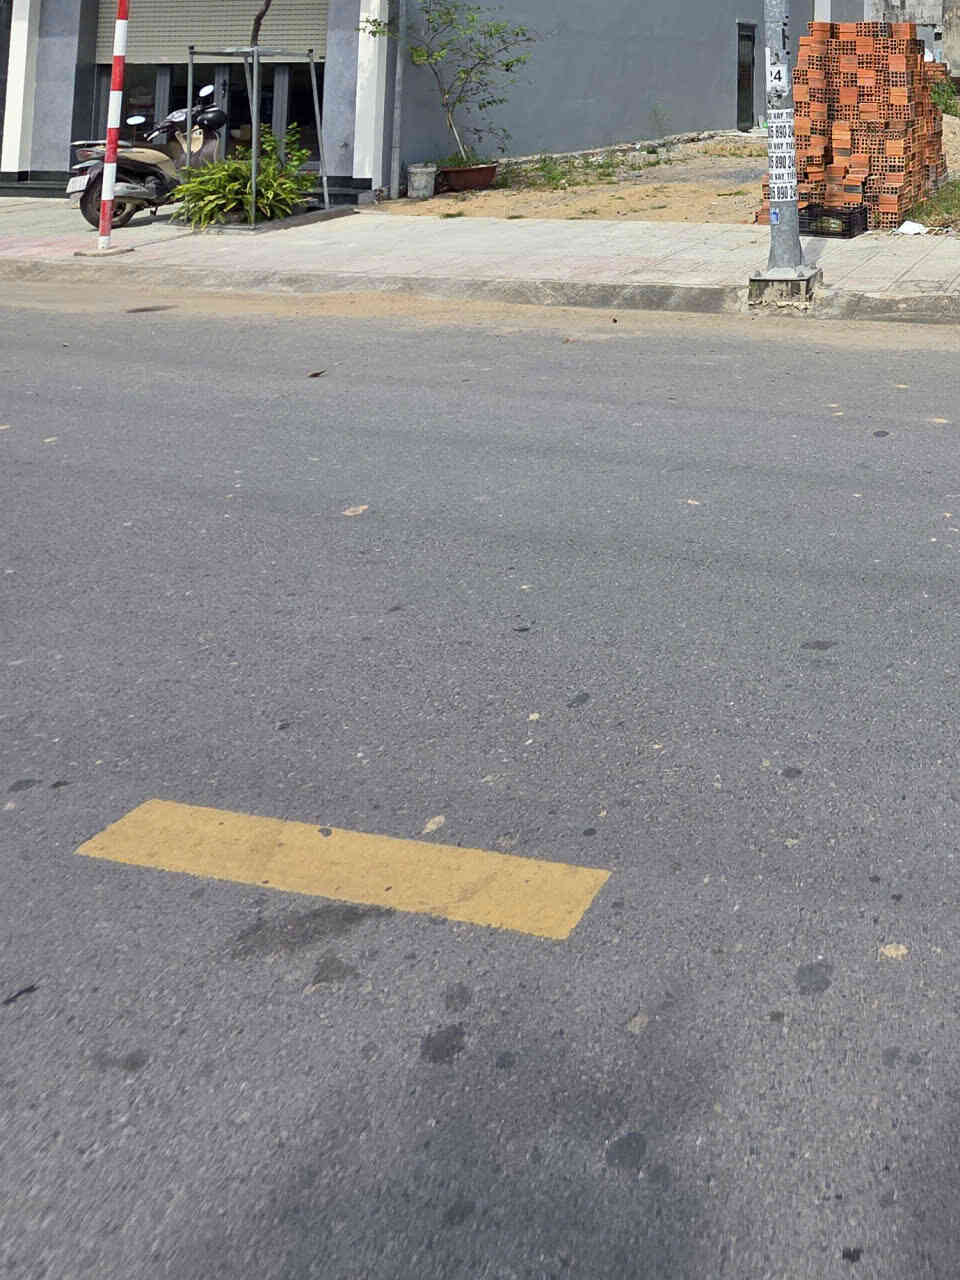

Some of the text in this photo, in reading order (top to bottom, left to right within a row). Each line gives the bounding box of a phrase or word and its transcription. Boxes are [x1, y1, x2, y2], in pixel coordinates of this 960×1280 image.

[775, 124, 787, 139] 890
[775, 155, 787, 169] 890
[776, 186, 789, 200] 890
